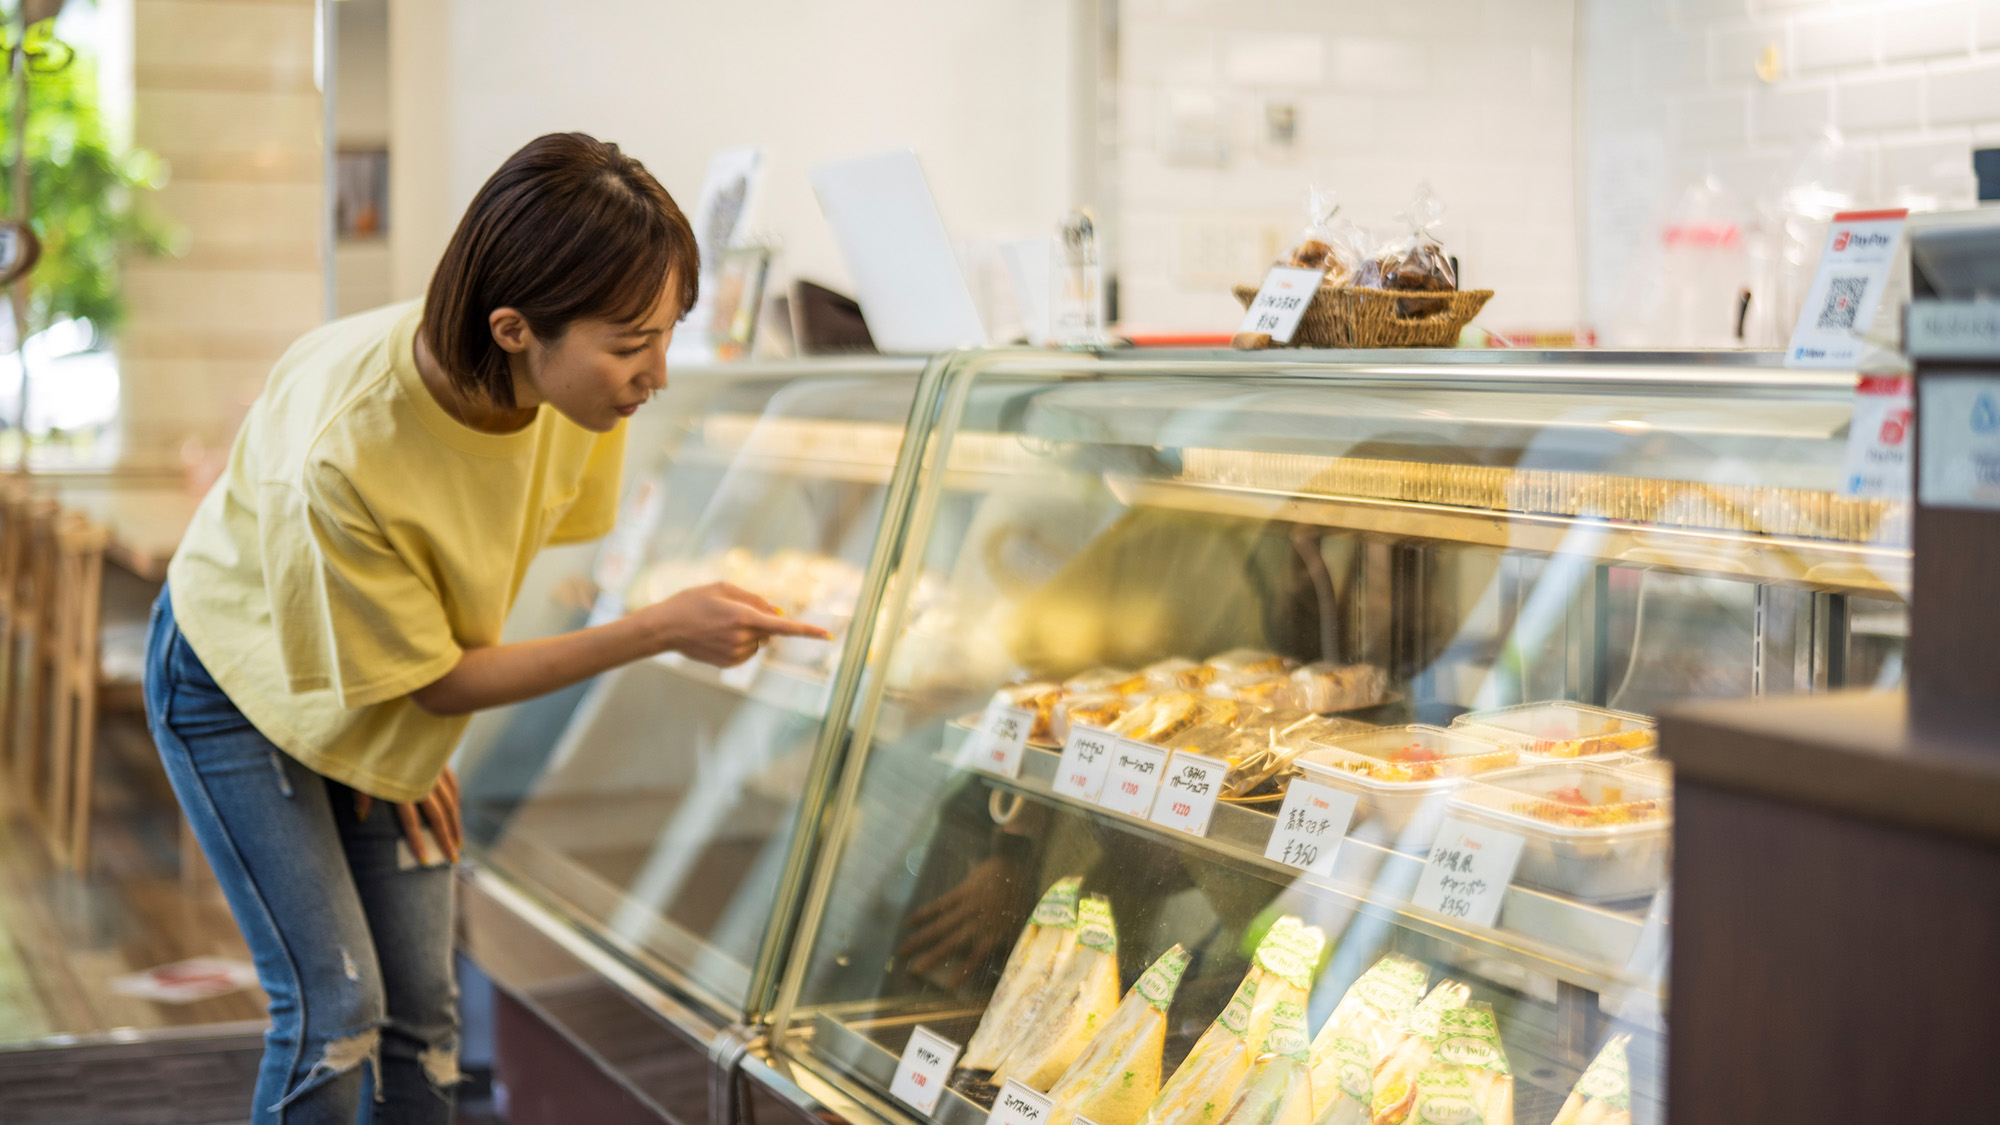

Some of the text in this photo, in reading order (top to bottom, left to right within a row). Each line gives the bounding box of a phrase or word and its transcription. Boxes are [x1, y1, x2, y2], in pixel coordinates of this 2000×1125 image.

[1849, 233, 1891, 250] PayPay
[1182, 765, 1207, 781] くるみの
[1169, 775, 1210, 796] ガトーショコラ
[1171, 801, 1191, 817] ¥220
[1282, 838, 1318, 866] ¥350
[1432, 847, 1473, 873] 沖縄風
[1439, 895, 1471, 917] ¥350
[1004, 1093, 1041, 1121] ミックスサンド
